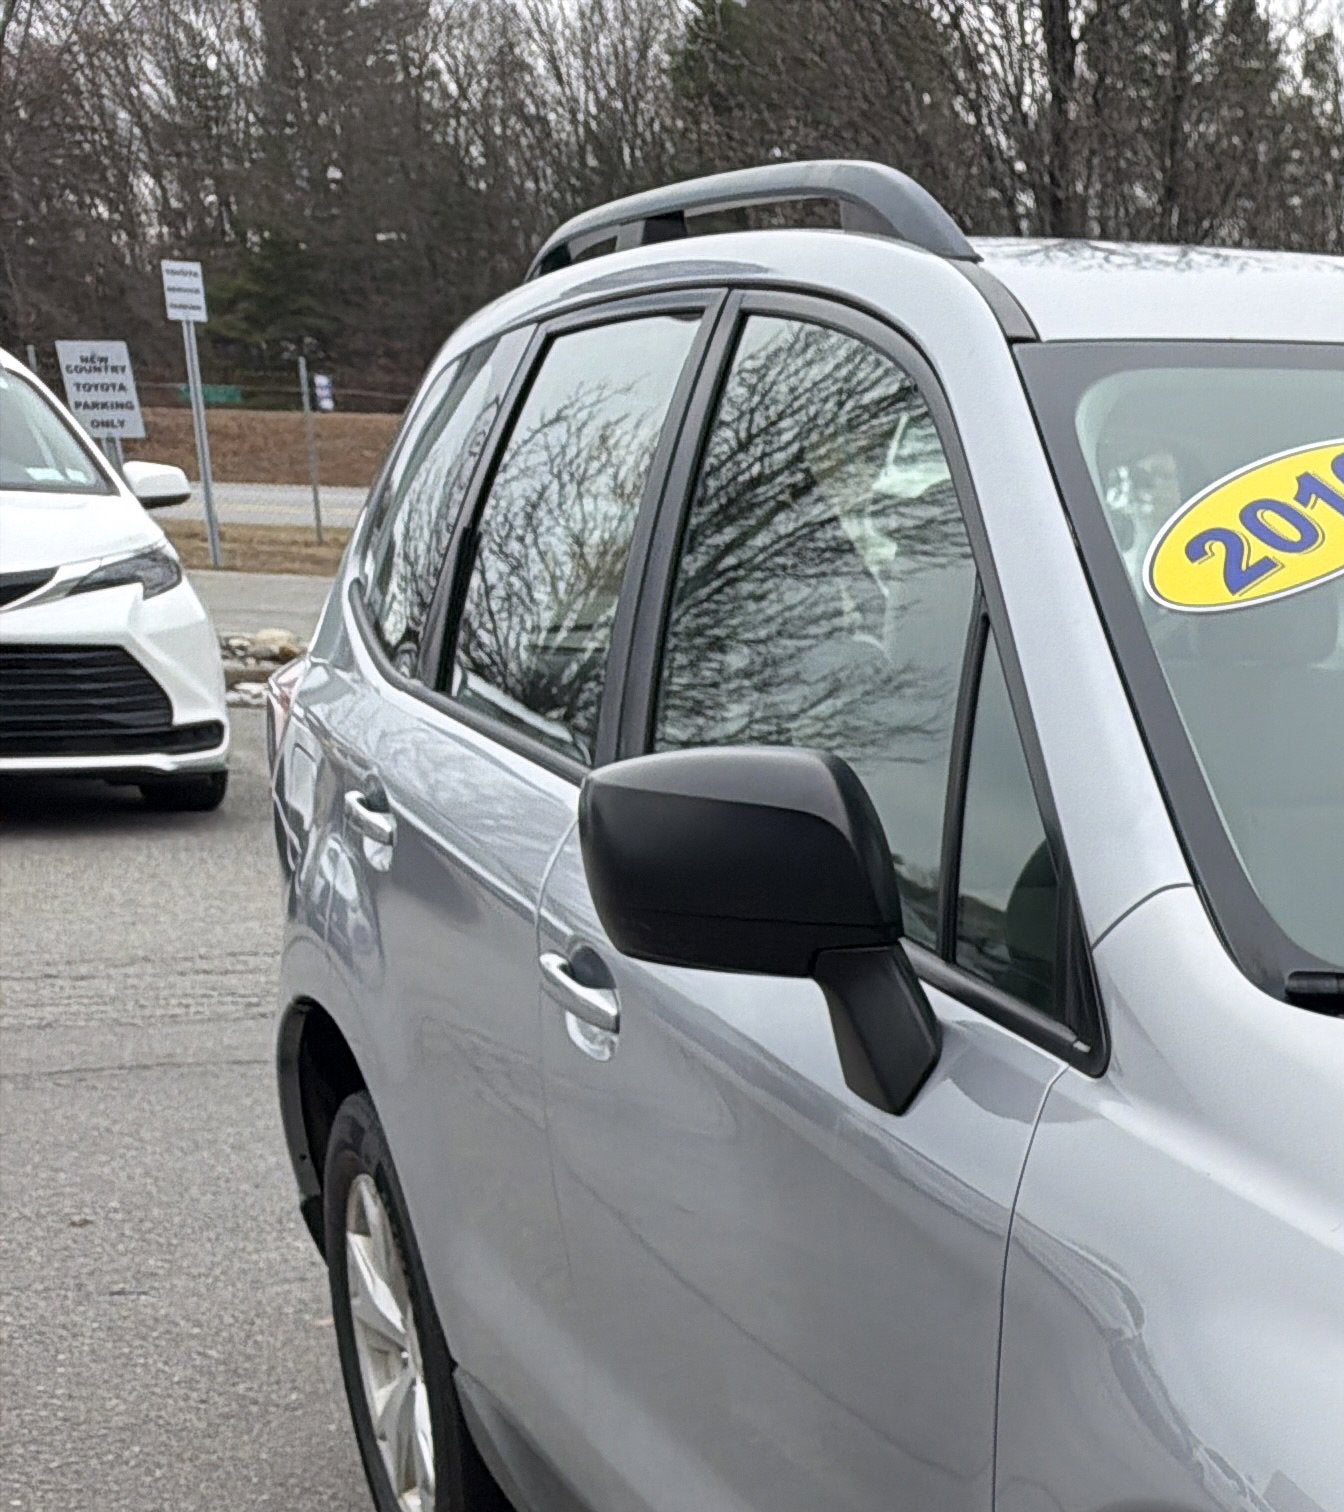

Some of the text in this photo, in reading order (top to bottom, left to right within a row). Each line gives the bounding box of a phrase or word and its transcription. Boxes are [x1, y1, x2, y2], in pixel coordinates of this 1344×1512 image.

[79, 354, 109, 364] NEW
[65, 364, 127, 374] COUNTRY
[73, 382, 128, 393] TOYOTA
[74, 401, 135, 411] PARKING
[90, 419, 126, 429] ONLY
